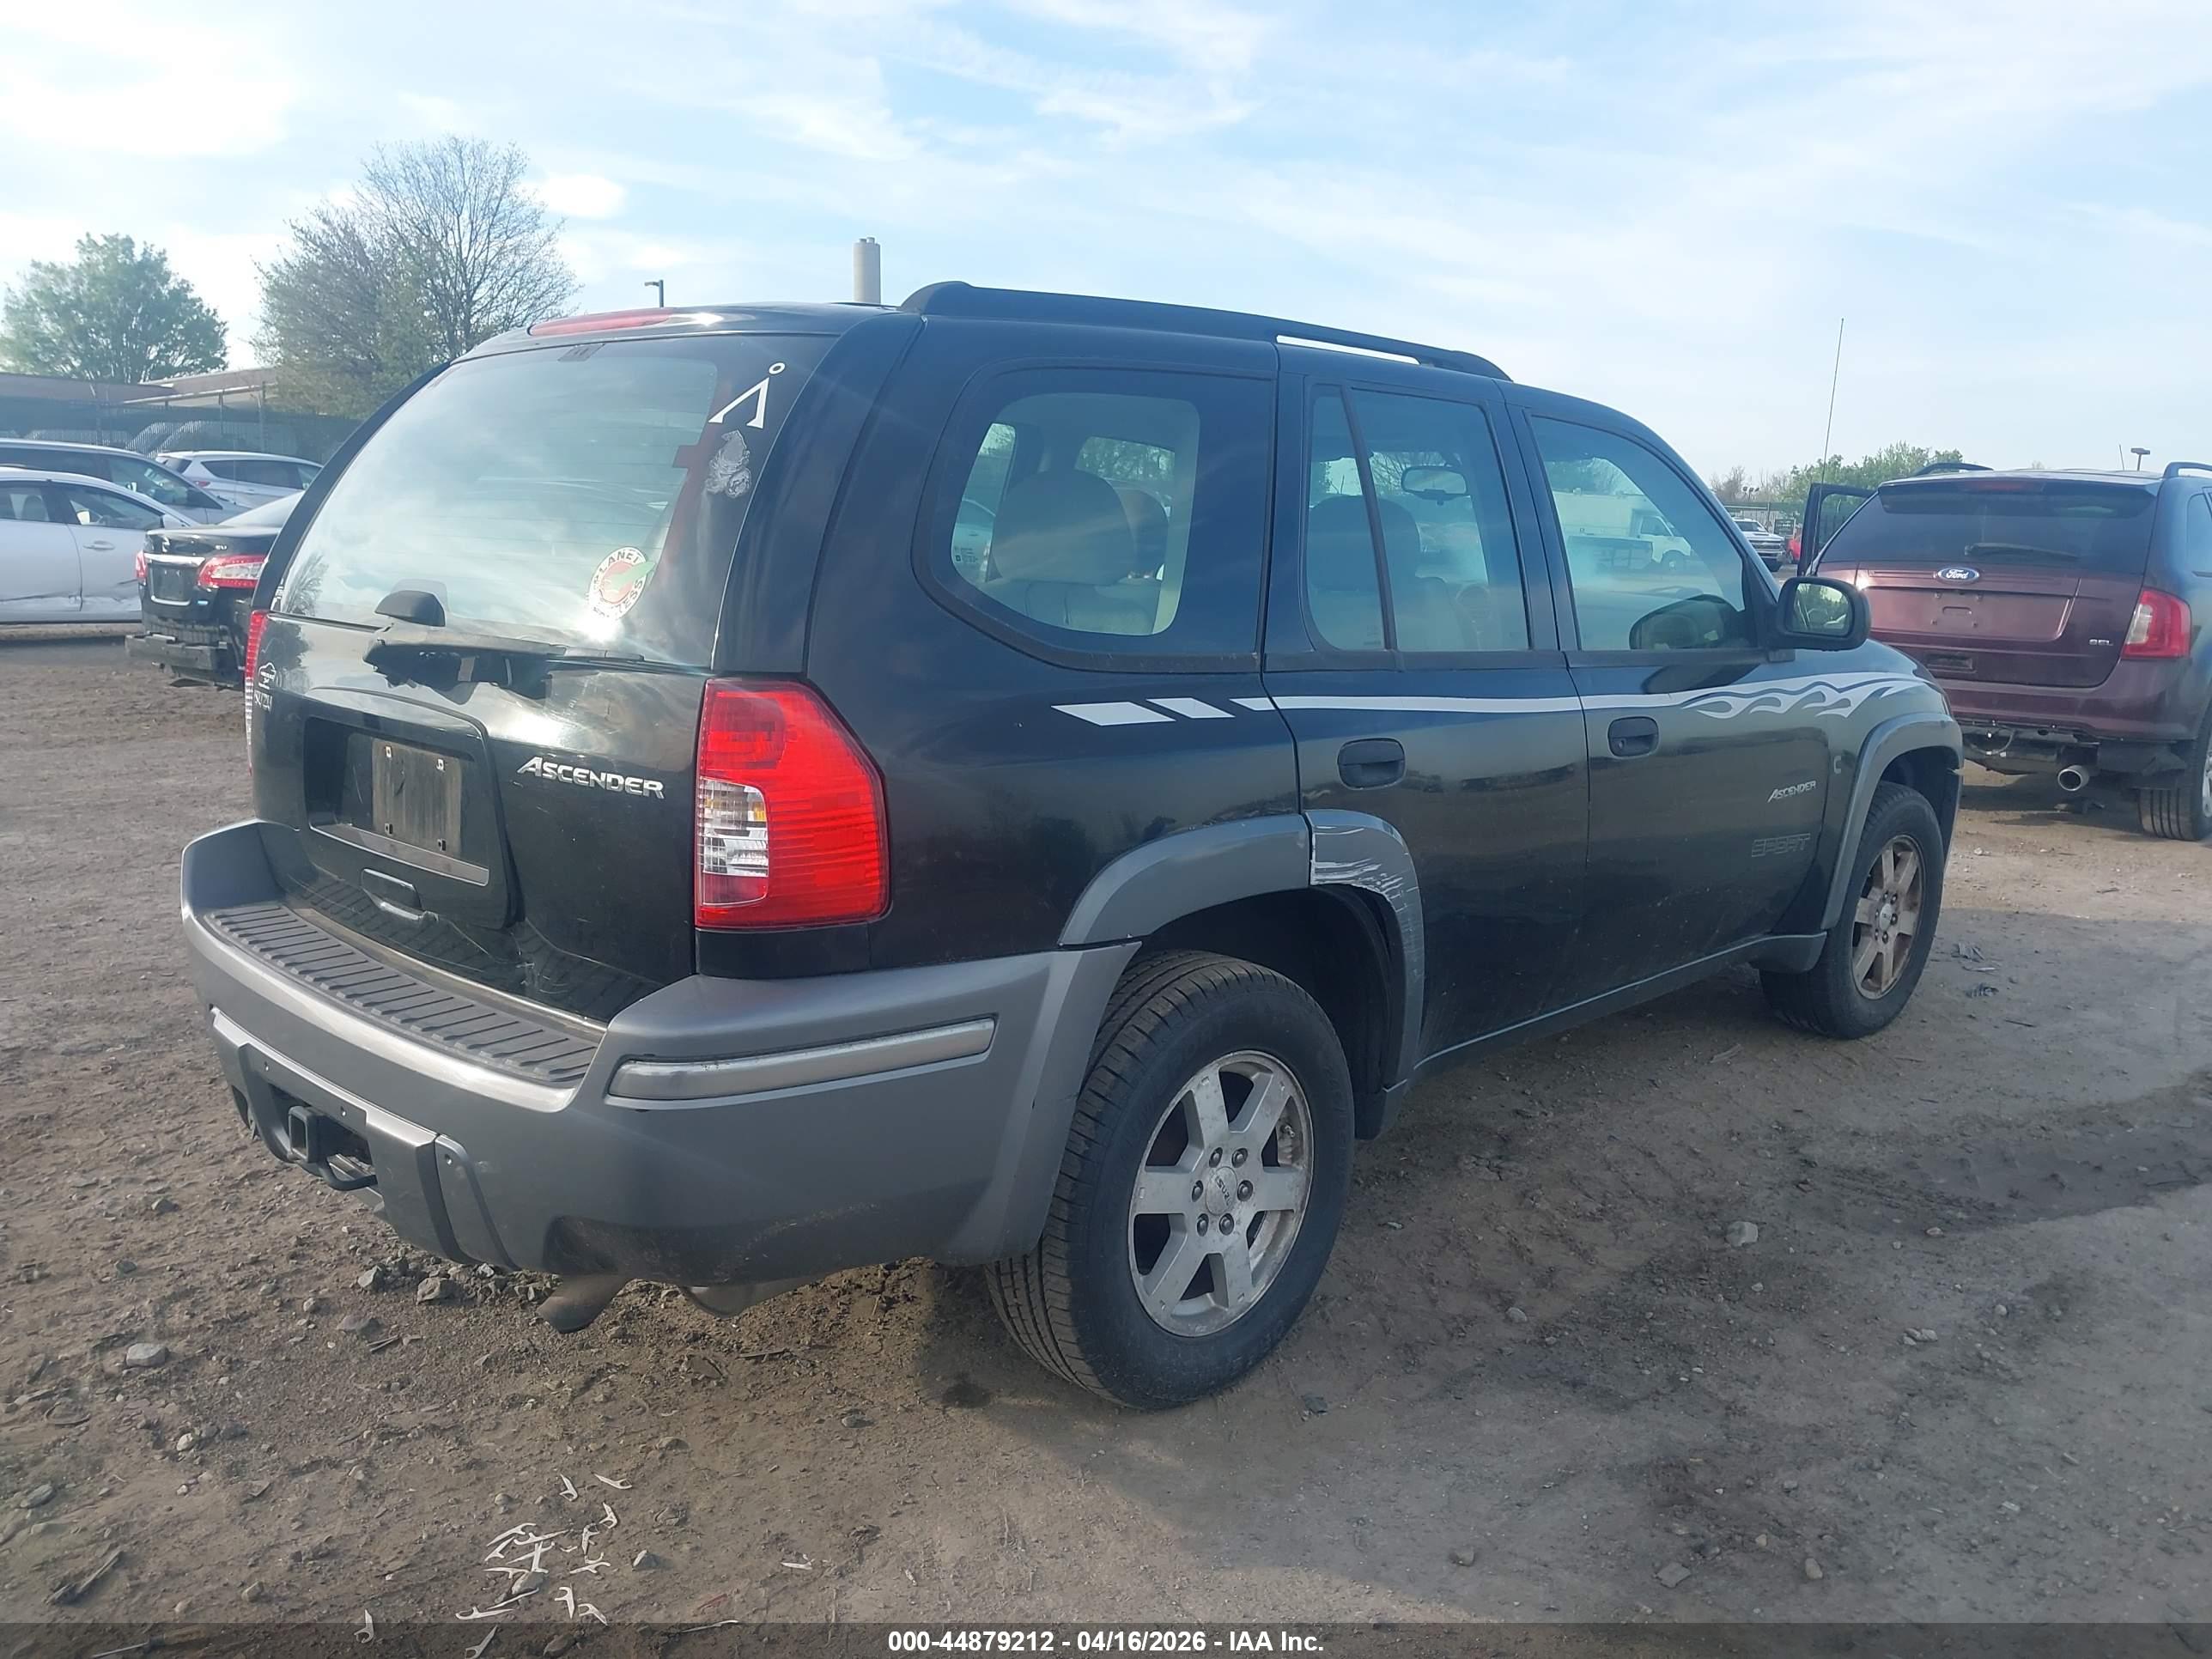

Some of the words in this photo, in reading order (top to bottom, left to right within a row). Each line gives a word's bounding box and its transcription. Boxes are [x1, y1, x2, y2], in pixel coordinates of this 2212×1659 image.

[1946, 568, 1970, 579] Ford
[517, 756, 665, 799] ASCENDER
[1767, 780, 1816, 803] ASCENDER
